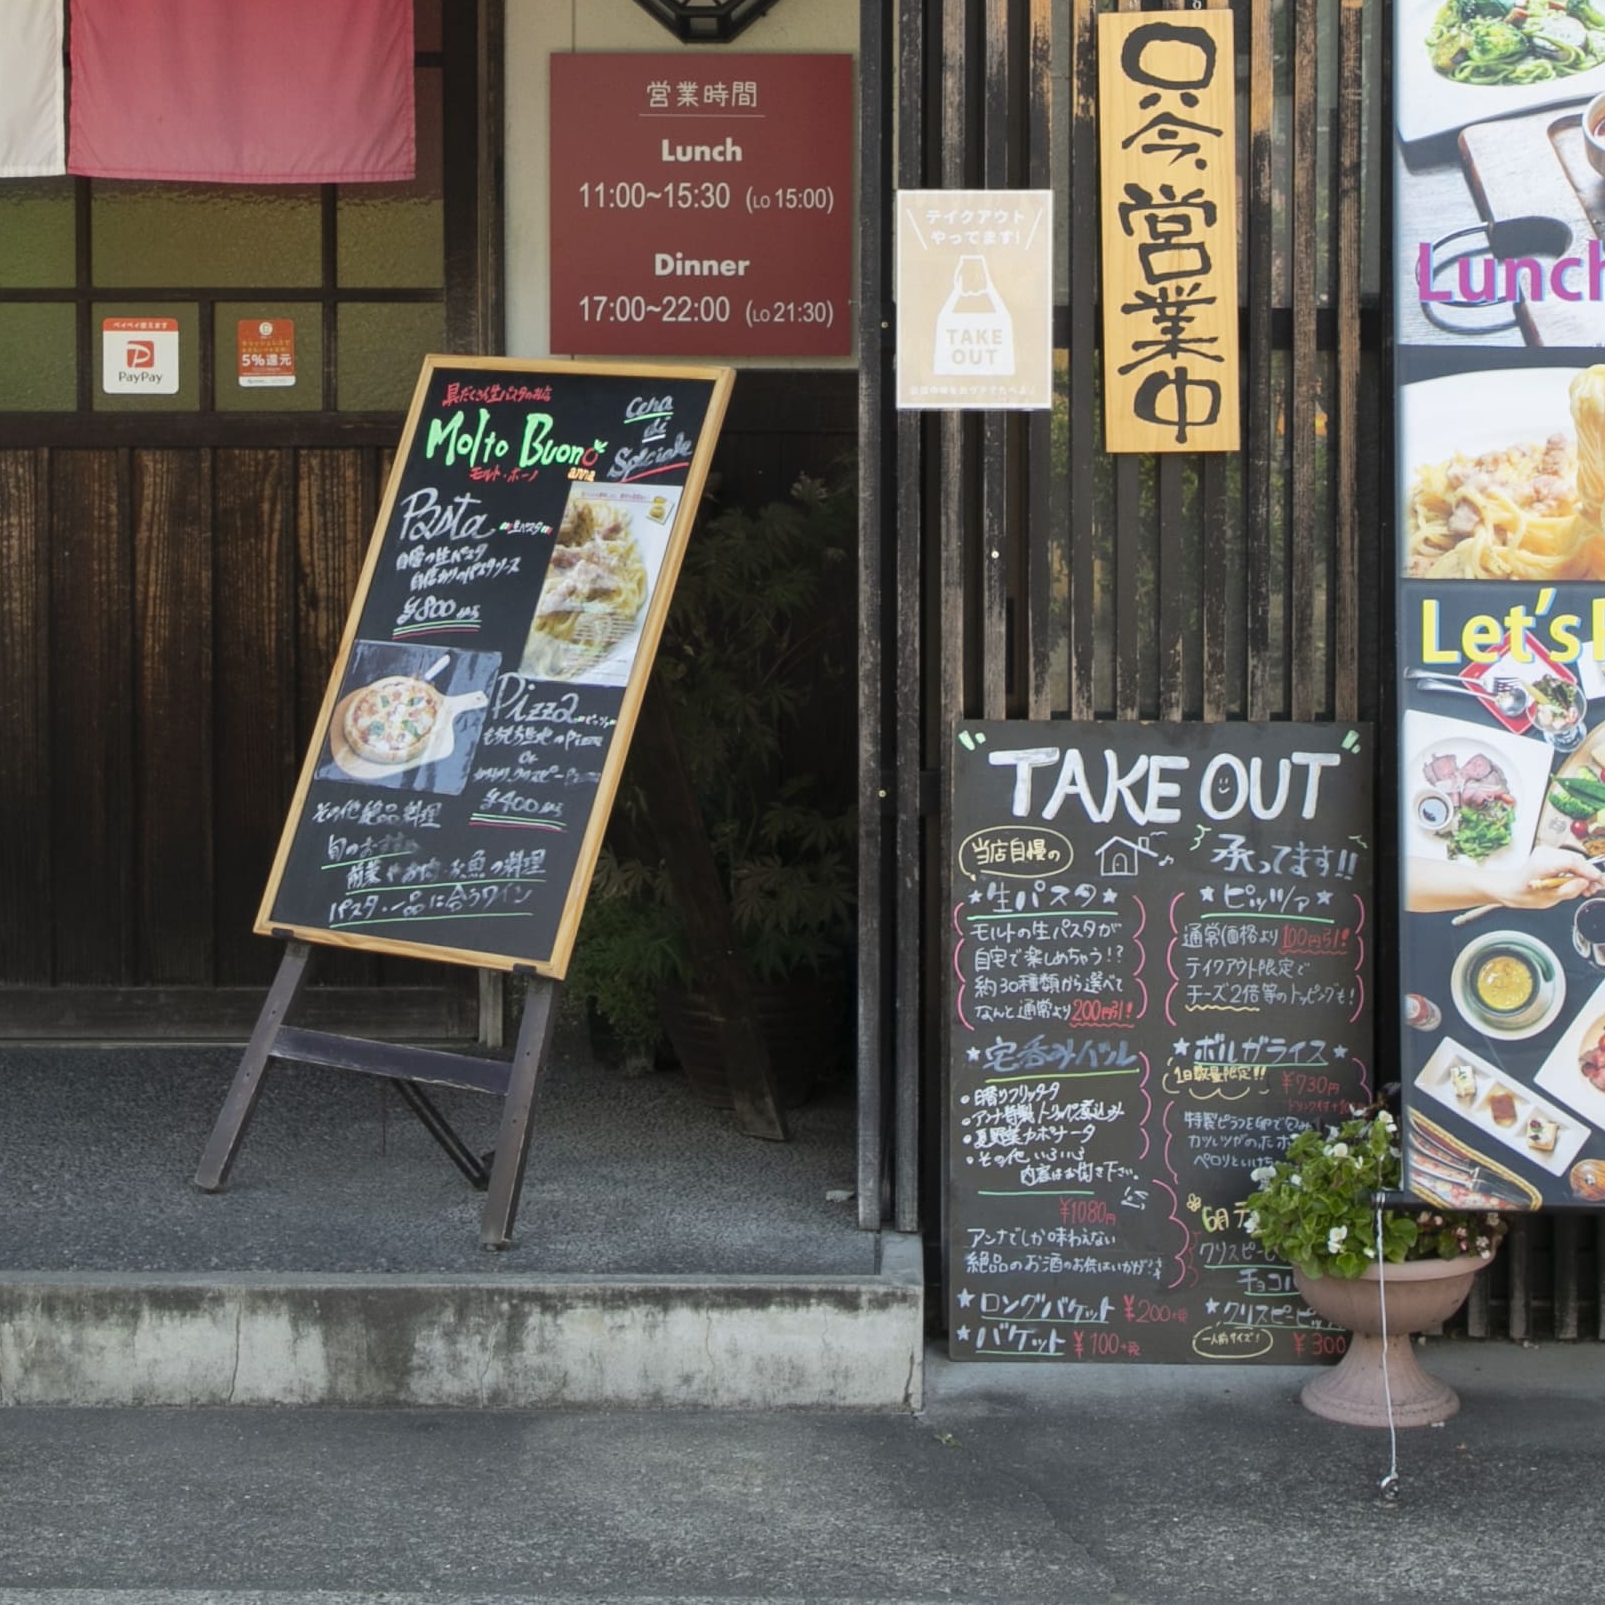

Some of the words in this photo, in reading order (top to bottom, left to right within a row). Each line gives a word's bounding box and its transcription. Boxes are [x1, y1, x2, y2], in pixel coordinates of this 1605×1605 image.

[646, 80, 757, 108] 営業時間
[661, 137, 743, 162] Lunch
[926, 209, 1026, 224] テイクアウト
[930, 230, 1021, 245] やってます!
[1117, 20, 1226, 445] 只今営業中
[654, 252, 750, 277] Dinner
[946, 329, 1003, 345] TAKE
[952, 349, 999, 365] OUT
[118, 371, 163, 385] PayPay
[426, 408, 509, 468] Molto
[519, 412, 608, 469] Buono
[567, 467, 596, 482] anna
[399, 486, 496, 541] Pasta
[492, 672, 580, 724] Pizza
[988, 746, 1190, 826] TAKE
[1200, 751, 1341, 821] OUT
[972, 837, 1061, 865] 当店自慢の
[987, 880, 1097, 913] 生パスタ
[970, 919, 1123, 943] モルトの生パスタが
[1194, 1033, 1328, 1063] ボルガライス
[980, 1292, 1115, 1323] ロングバケット
[976, 1322, 1066, 1355] バケット
